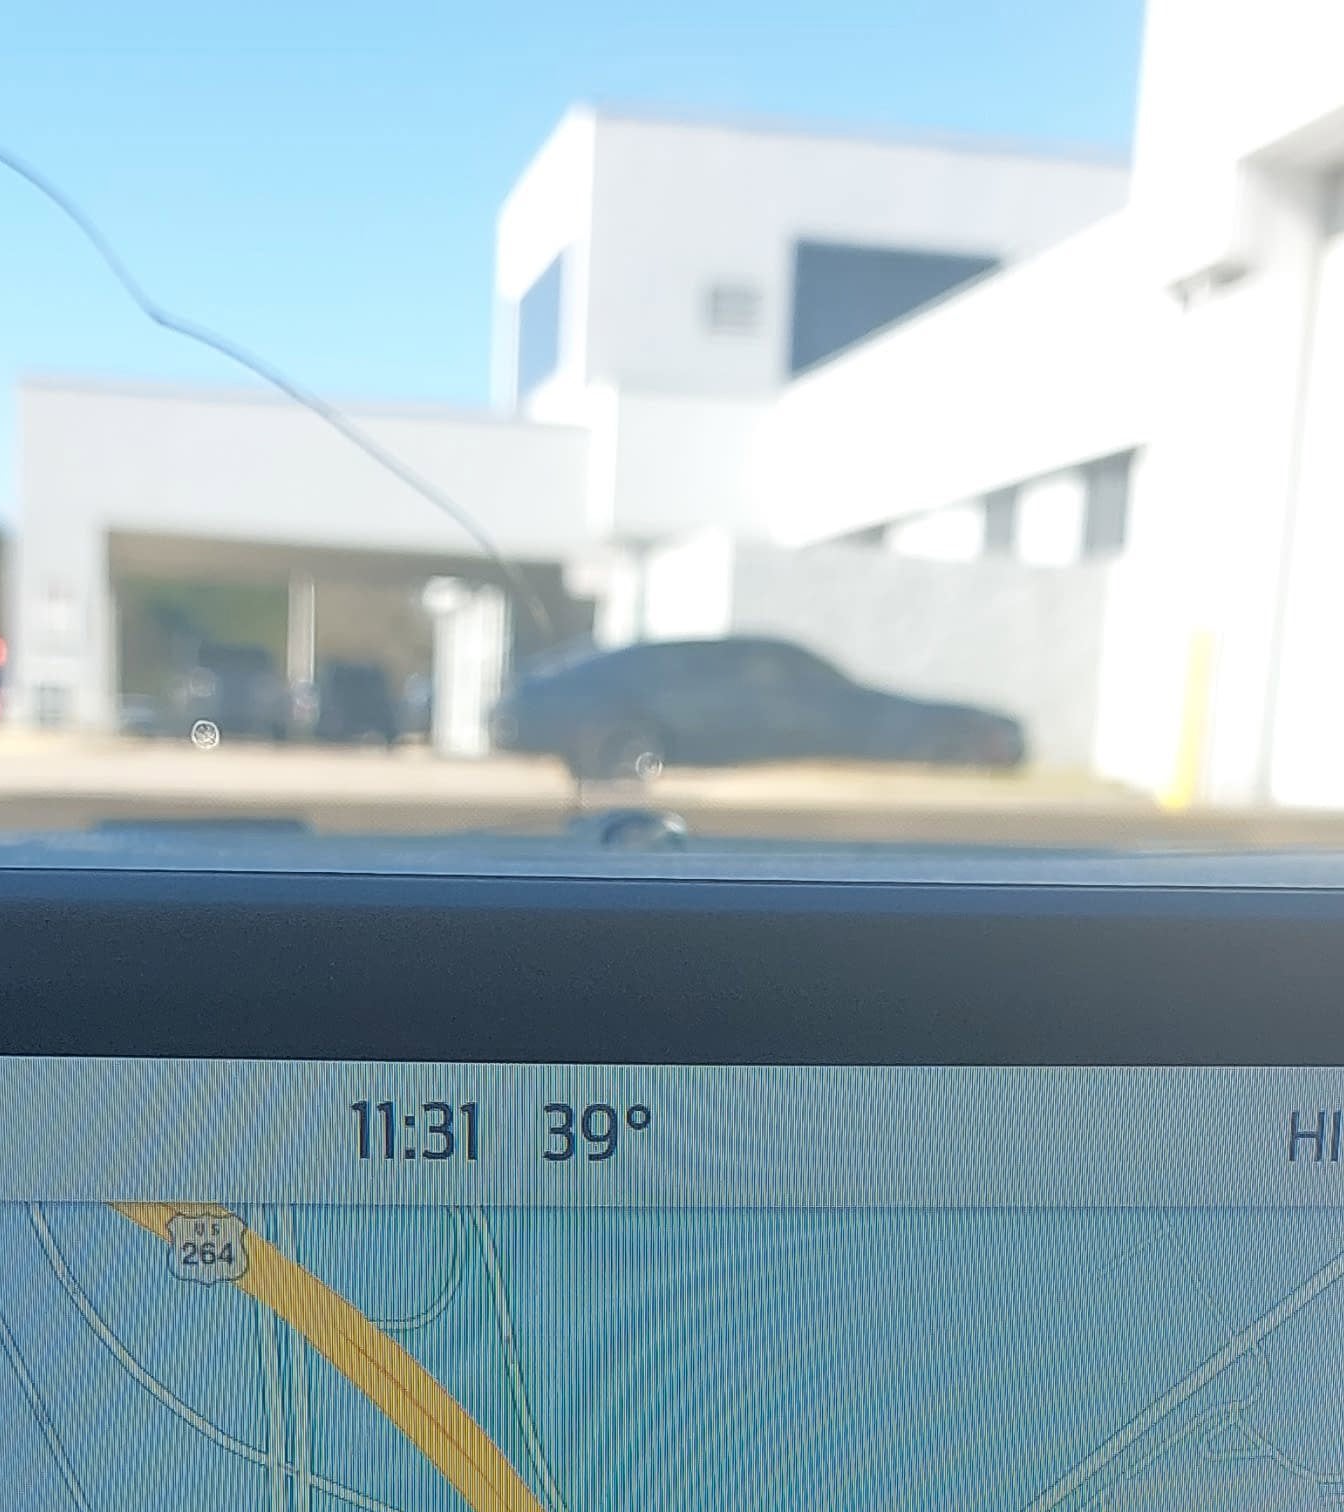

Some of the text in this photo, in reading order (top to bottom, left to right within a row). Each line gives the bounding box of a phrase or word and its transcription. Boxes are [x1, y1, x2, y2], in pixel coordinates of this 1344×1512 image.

[351, 1100, 652, 1162] 11:31 39°
[1288, 1110, 1342, 1162] HI
[181, 1241, 234, 1265] 264
